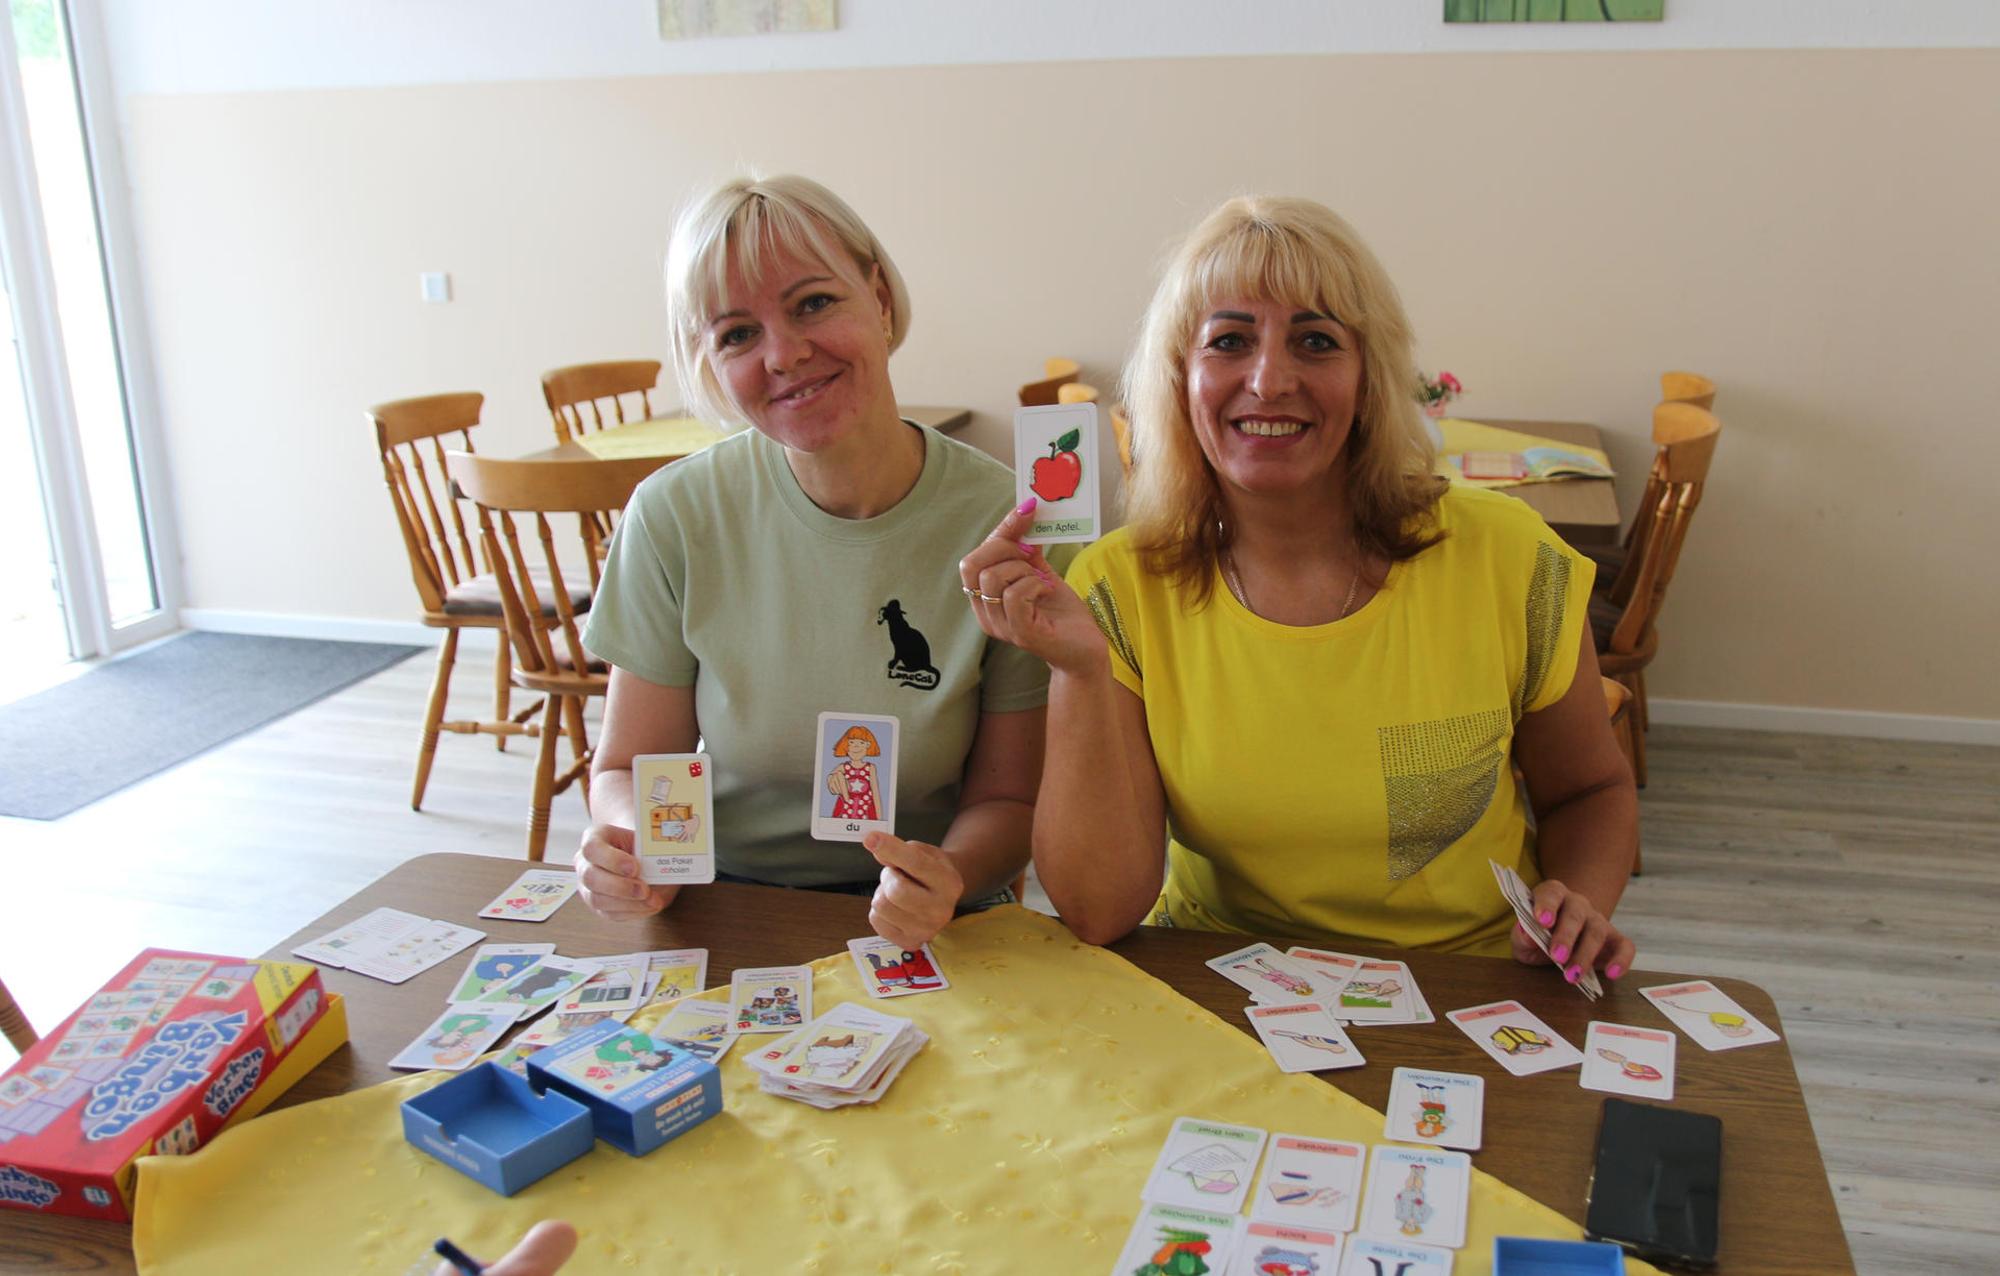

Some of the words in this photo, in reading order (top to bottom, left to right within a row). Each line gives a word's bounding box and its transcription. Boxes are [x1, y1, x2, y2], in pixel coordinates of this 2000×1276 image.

[1035, 522, 1053, 533] den
[846, 822, 861, 832] du
[656, 857, 671, 866] das
[85, 1021, 205, 1118] Bingo
[87, 1010, 248, 1140] Verben
[203, 1047, 264, 1105] Verben
[216, 1066, 260, 1116] Bingo
[1425, 1156, 1445, 1166] Die
[0, 1167, 59, 1194] rben
[0, 1185, 51, 1206] ingo
